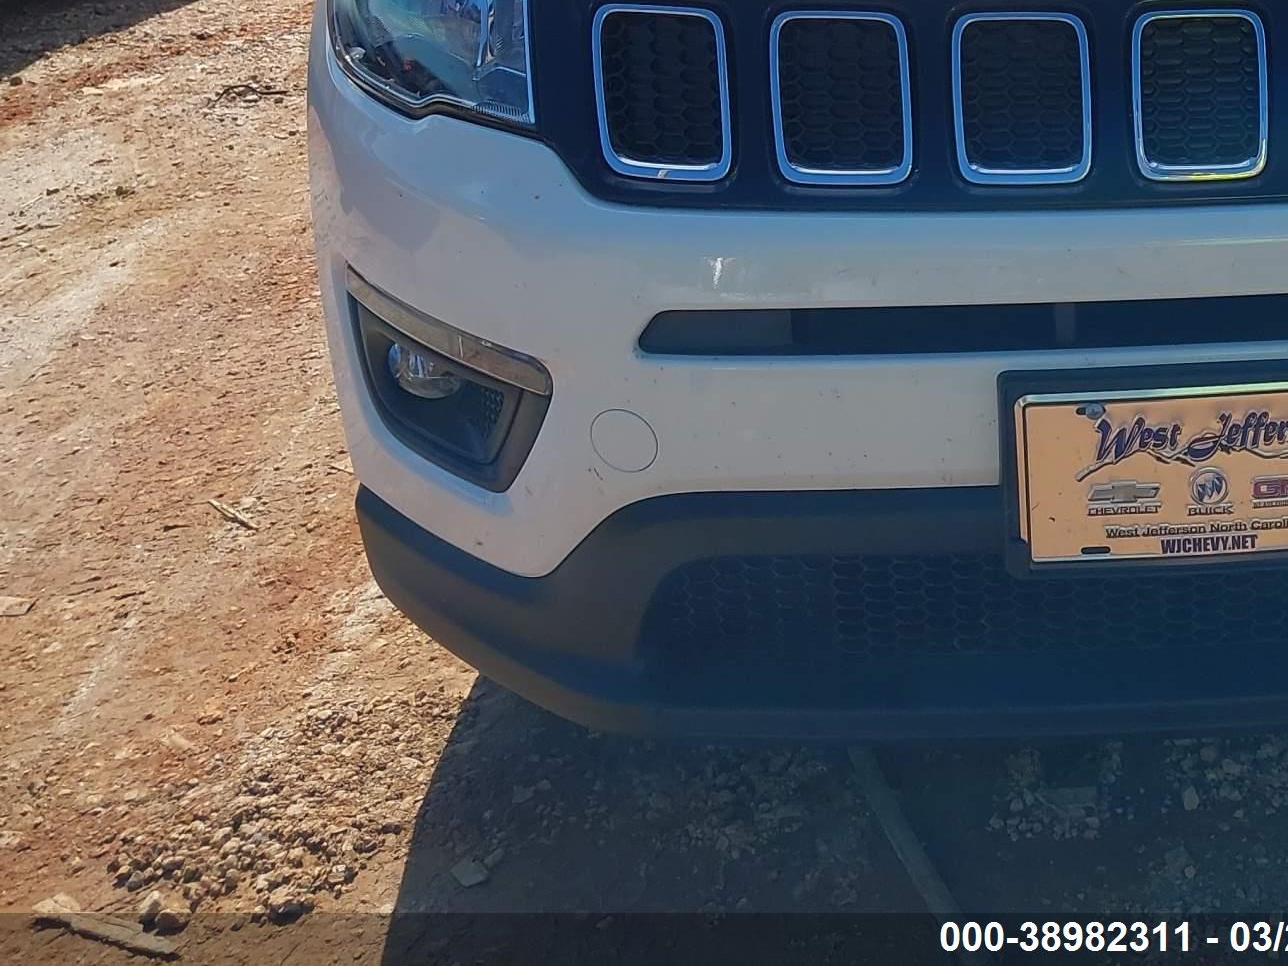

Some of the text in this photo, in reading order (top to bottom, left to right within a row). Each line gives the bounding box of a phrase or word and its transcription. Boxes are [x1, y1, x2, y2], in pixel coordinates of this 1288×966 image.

[1095, 412, 1182, 462] West
[1087, 504, 1162, 516] CHEVROLET
[1187, 504, 1234, 516] BUICK
[1105, 525, 1140, 538] West
[1141, 523, 1206, 537] Jefferson
[1209, 520, 1248, 533] North
[1161, 534, 1258, 554] WJCHEVY.NET
